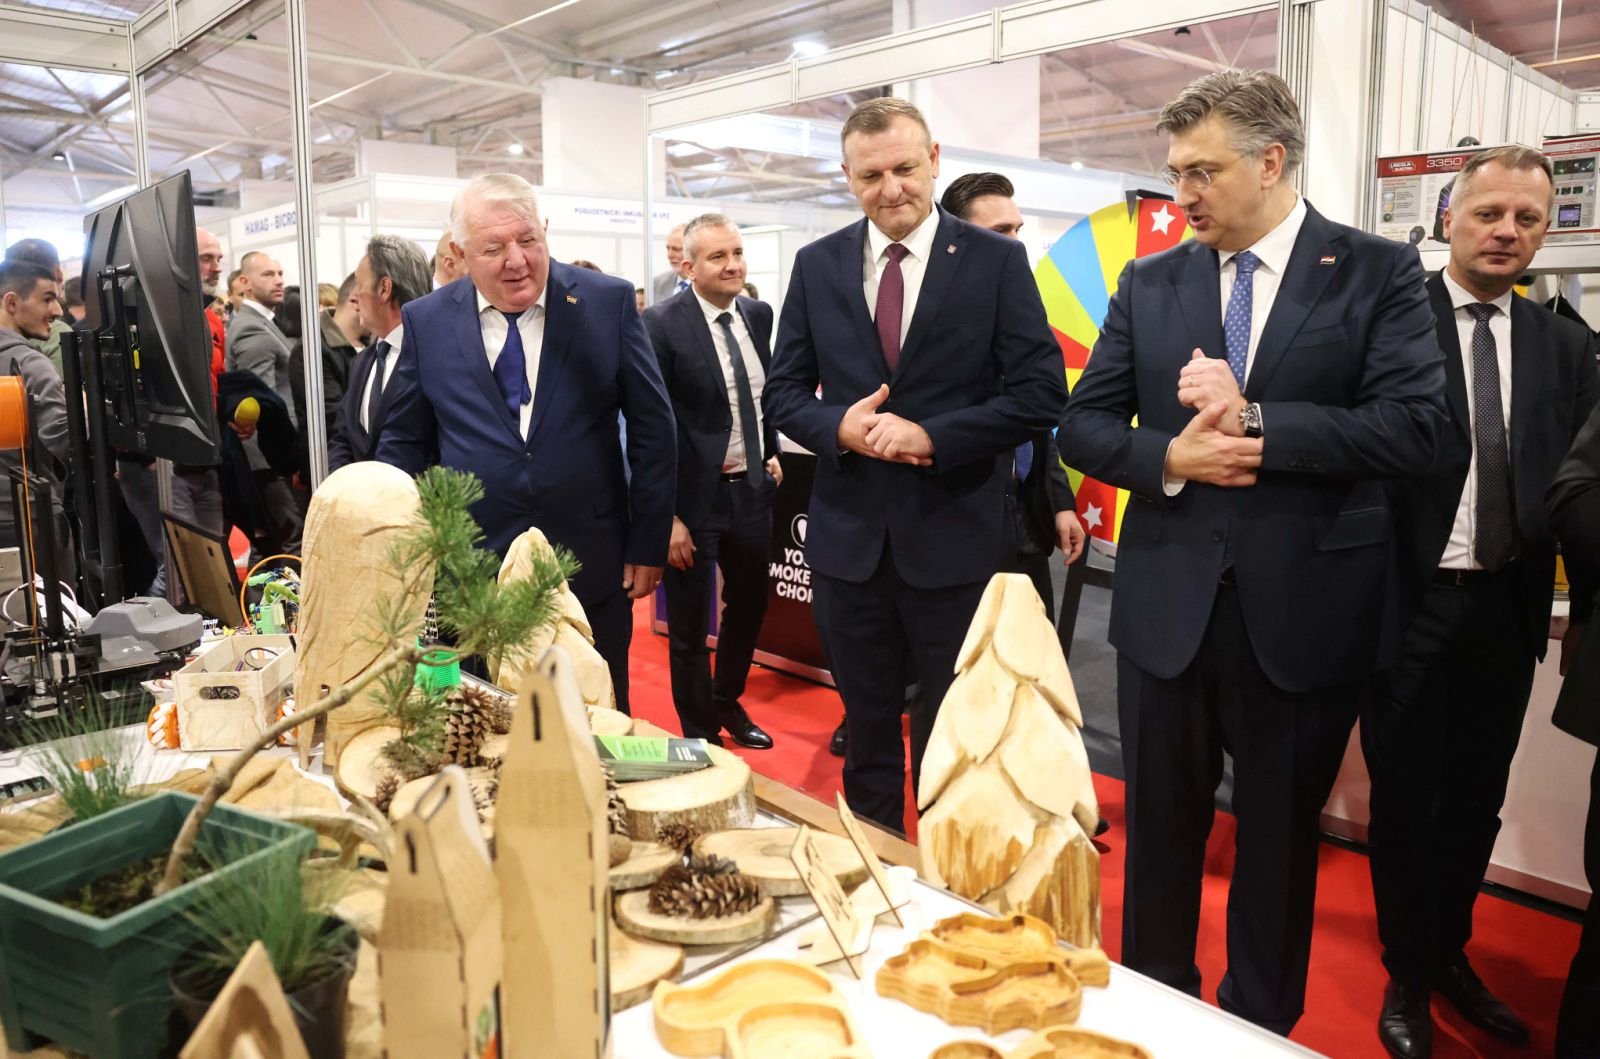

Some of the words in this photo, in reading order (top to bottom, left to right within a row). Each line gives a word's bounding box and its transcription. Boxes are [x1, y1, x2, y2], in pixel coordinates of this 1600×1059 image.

[1426, 157, 1463, 168] 3350
[245, 218, 269, 235] HAMAG
[784, 547, 809, 567] YO
[768, 562, 811, 585] MOKE
[776, 581, 813, 603] CHOI
